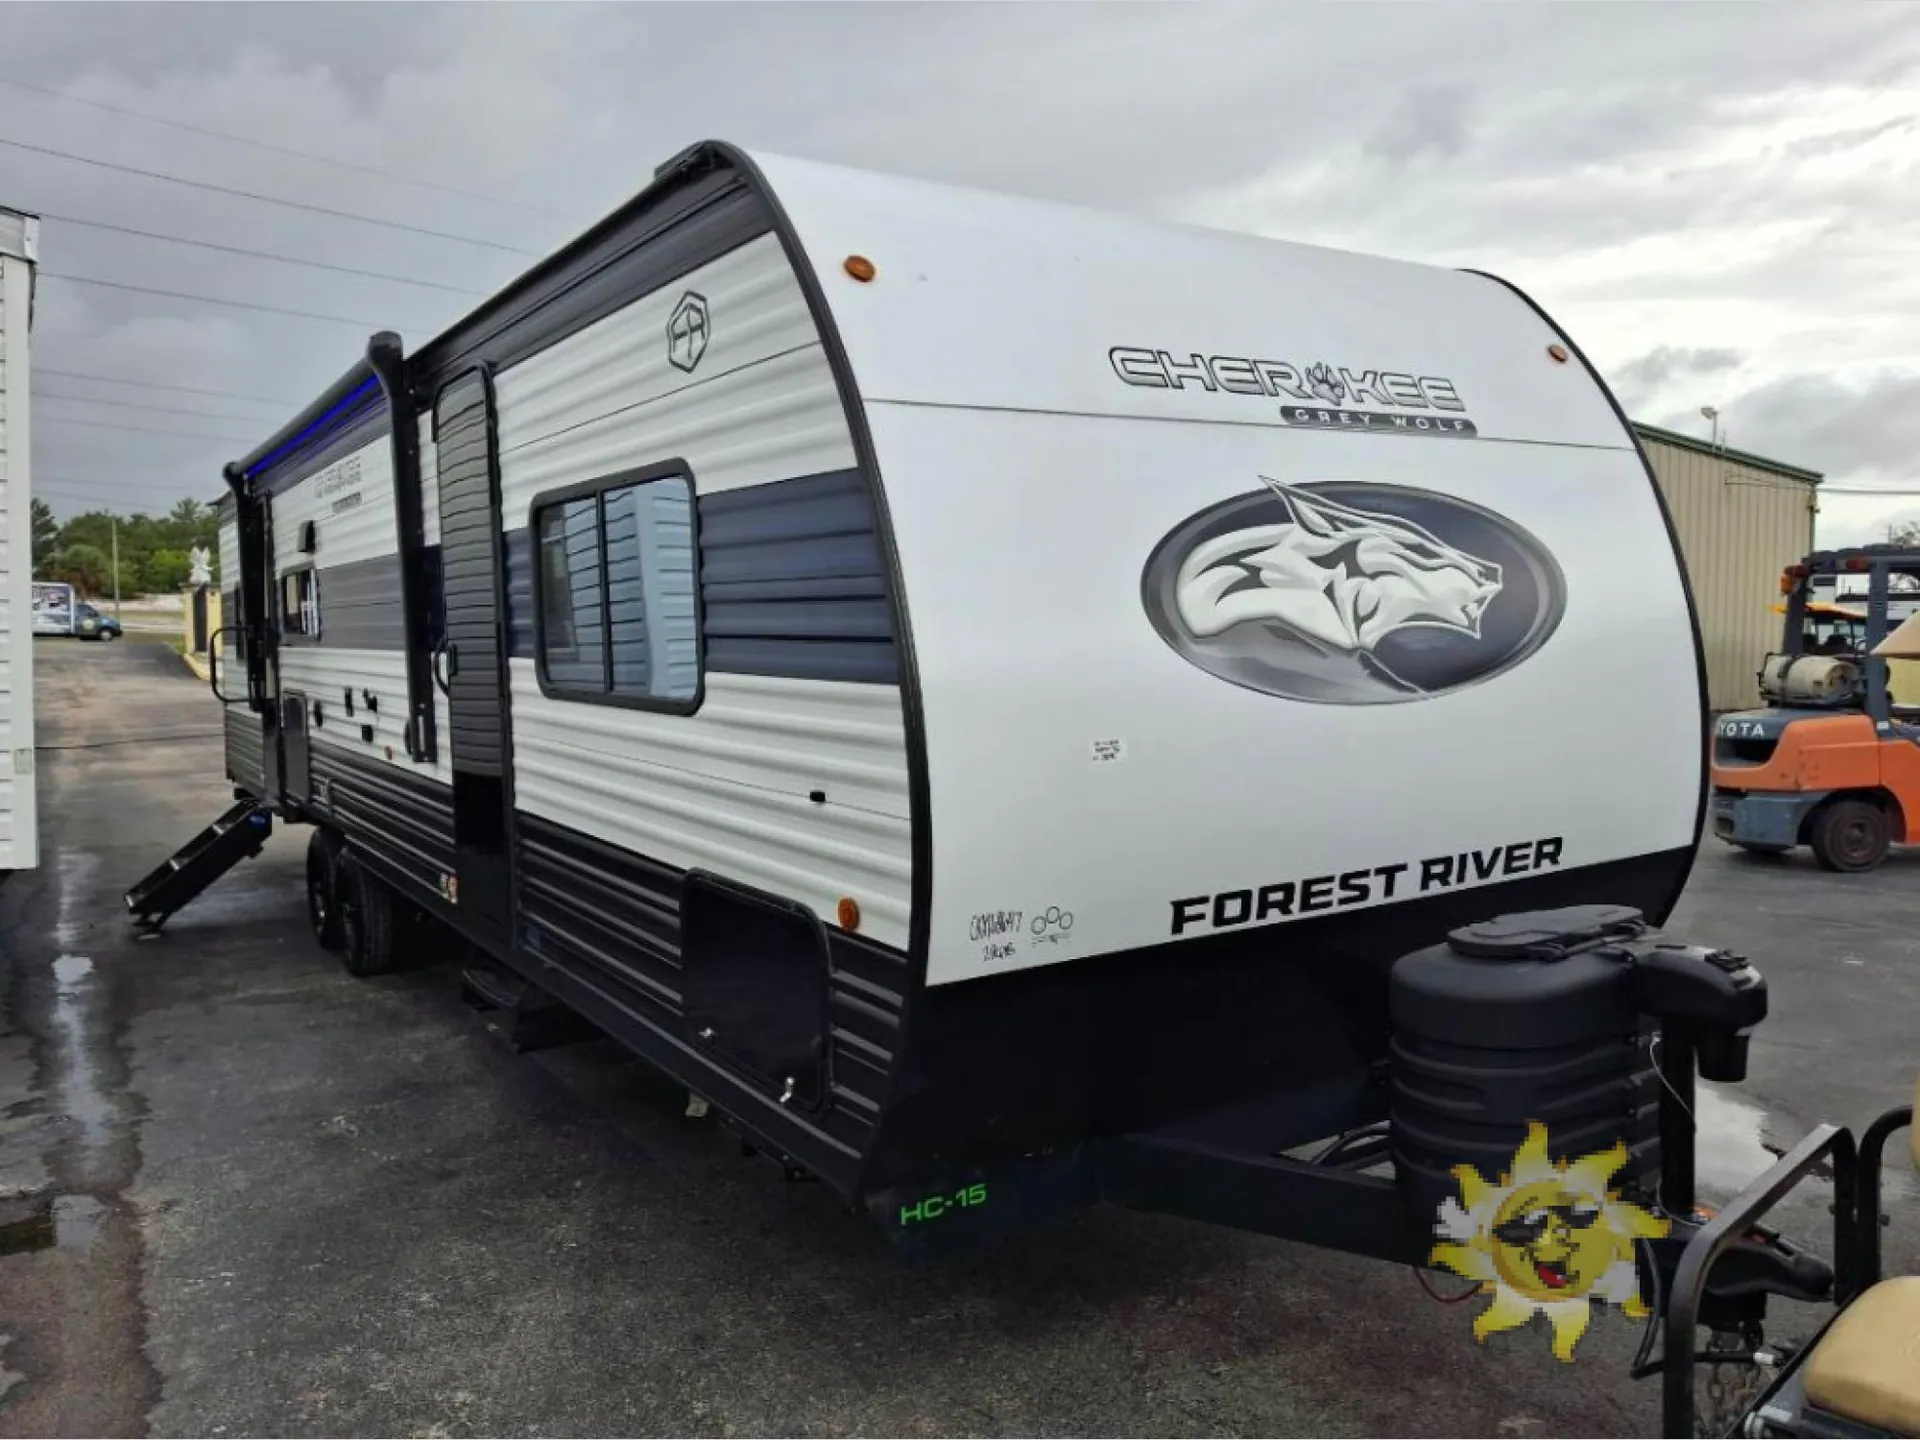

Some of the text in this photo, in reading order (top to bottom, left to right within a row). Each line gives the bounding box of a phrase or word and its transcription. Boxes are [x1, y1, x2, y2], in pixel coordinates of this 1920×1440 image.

[1295, 408, 1465, 431] GREY WOLF
[1170, 836, 1563, 935] FOREST RIVER
[900, 1183, 987, 1226] HC-15
